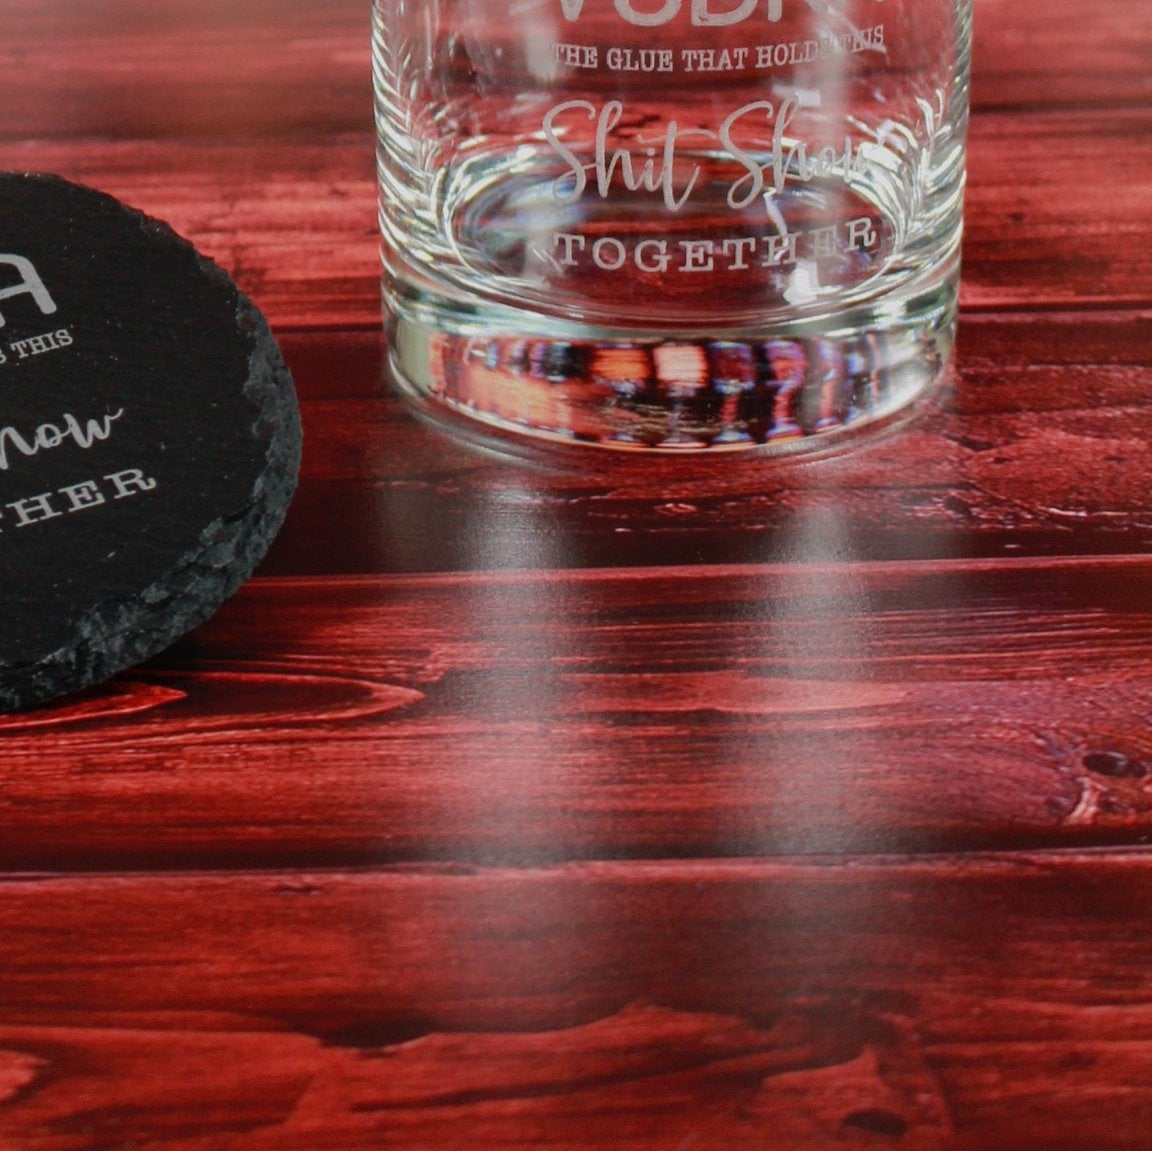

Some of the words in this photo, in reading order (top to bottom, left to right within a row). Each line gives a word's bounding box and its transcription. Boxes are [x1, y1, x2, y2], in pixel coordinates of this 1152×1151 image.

[552, 43, 598, 69] THE
[606, 47, 674, 72] GLUE
[681, 48, 748, 72] THAT
[542, 100, 717, 212] Shit
[552, 216, 877, 273] TOGETHER
[10, 328, 75, 360] THIS
